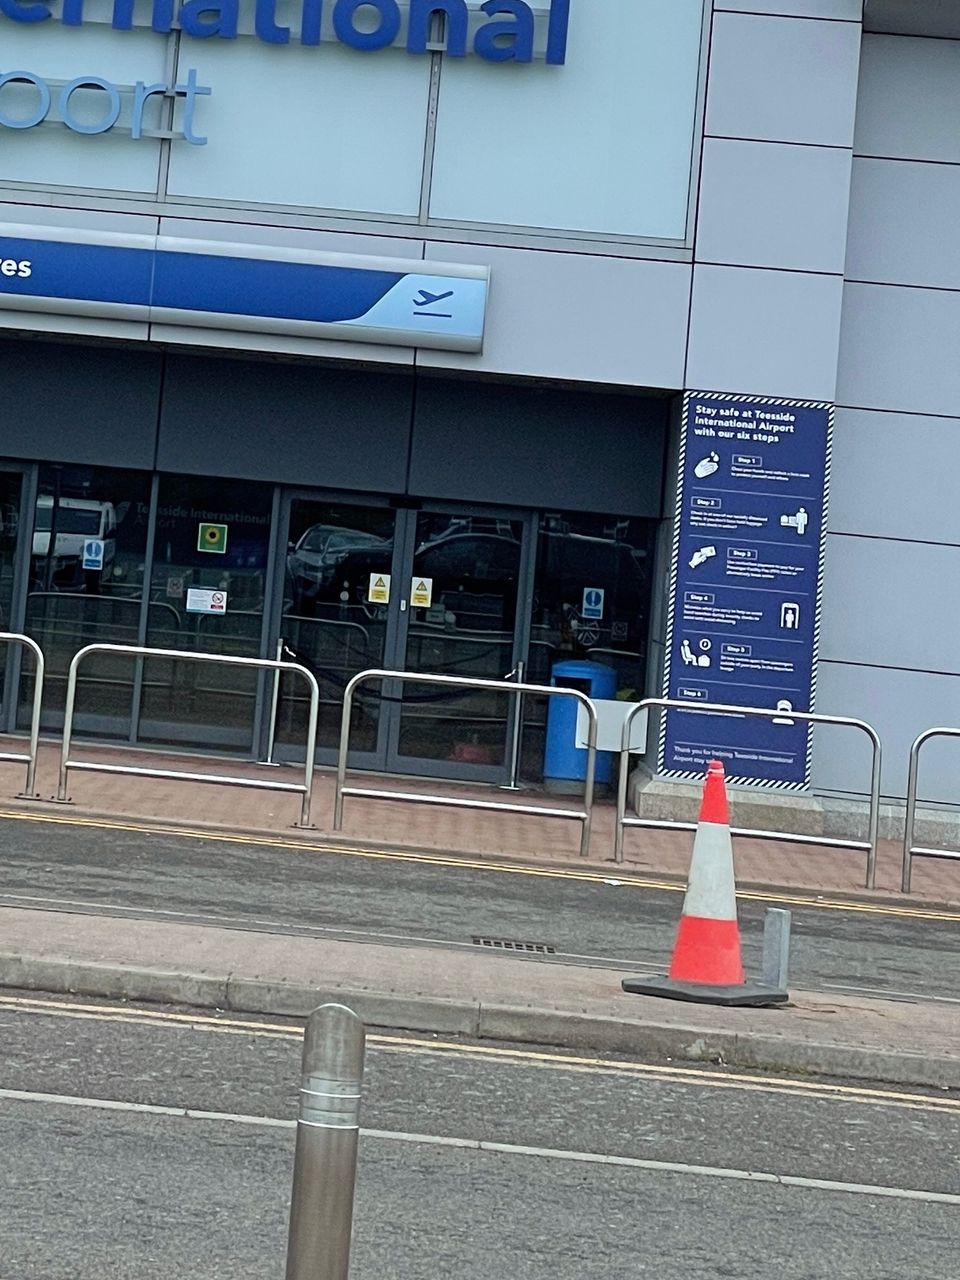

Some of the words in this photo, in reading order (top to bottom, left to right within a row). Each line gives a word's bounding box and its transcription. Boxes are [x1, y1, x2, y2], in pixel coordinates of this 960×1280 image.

[695, 405, 716, 417] Stay
[719, 408, 739, 417] safe
[741, 410, 752, 418] at
[755, 410, 795, 422] Teesside
[695, 416, 756, 429] International
[758, 421, 794, 433] Airport
[694, 427, 716, 437] with
[718, 430, 734, 439] our
[737, 430, 750, 440] six
[753, 433, 779, 443] steps
[673, 754, 692, 764] Airport
[674, 746, 689, 754] Thank
[691, 748, 703, 757] you
[703, 748, 712, 756] for
[712, 750, 733, 759] helping
